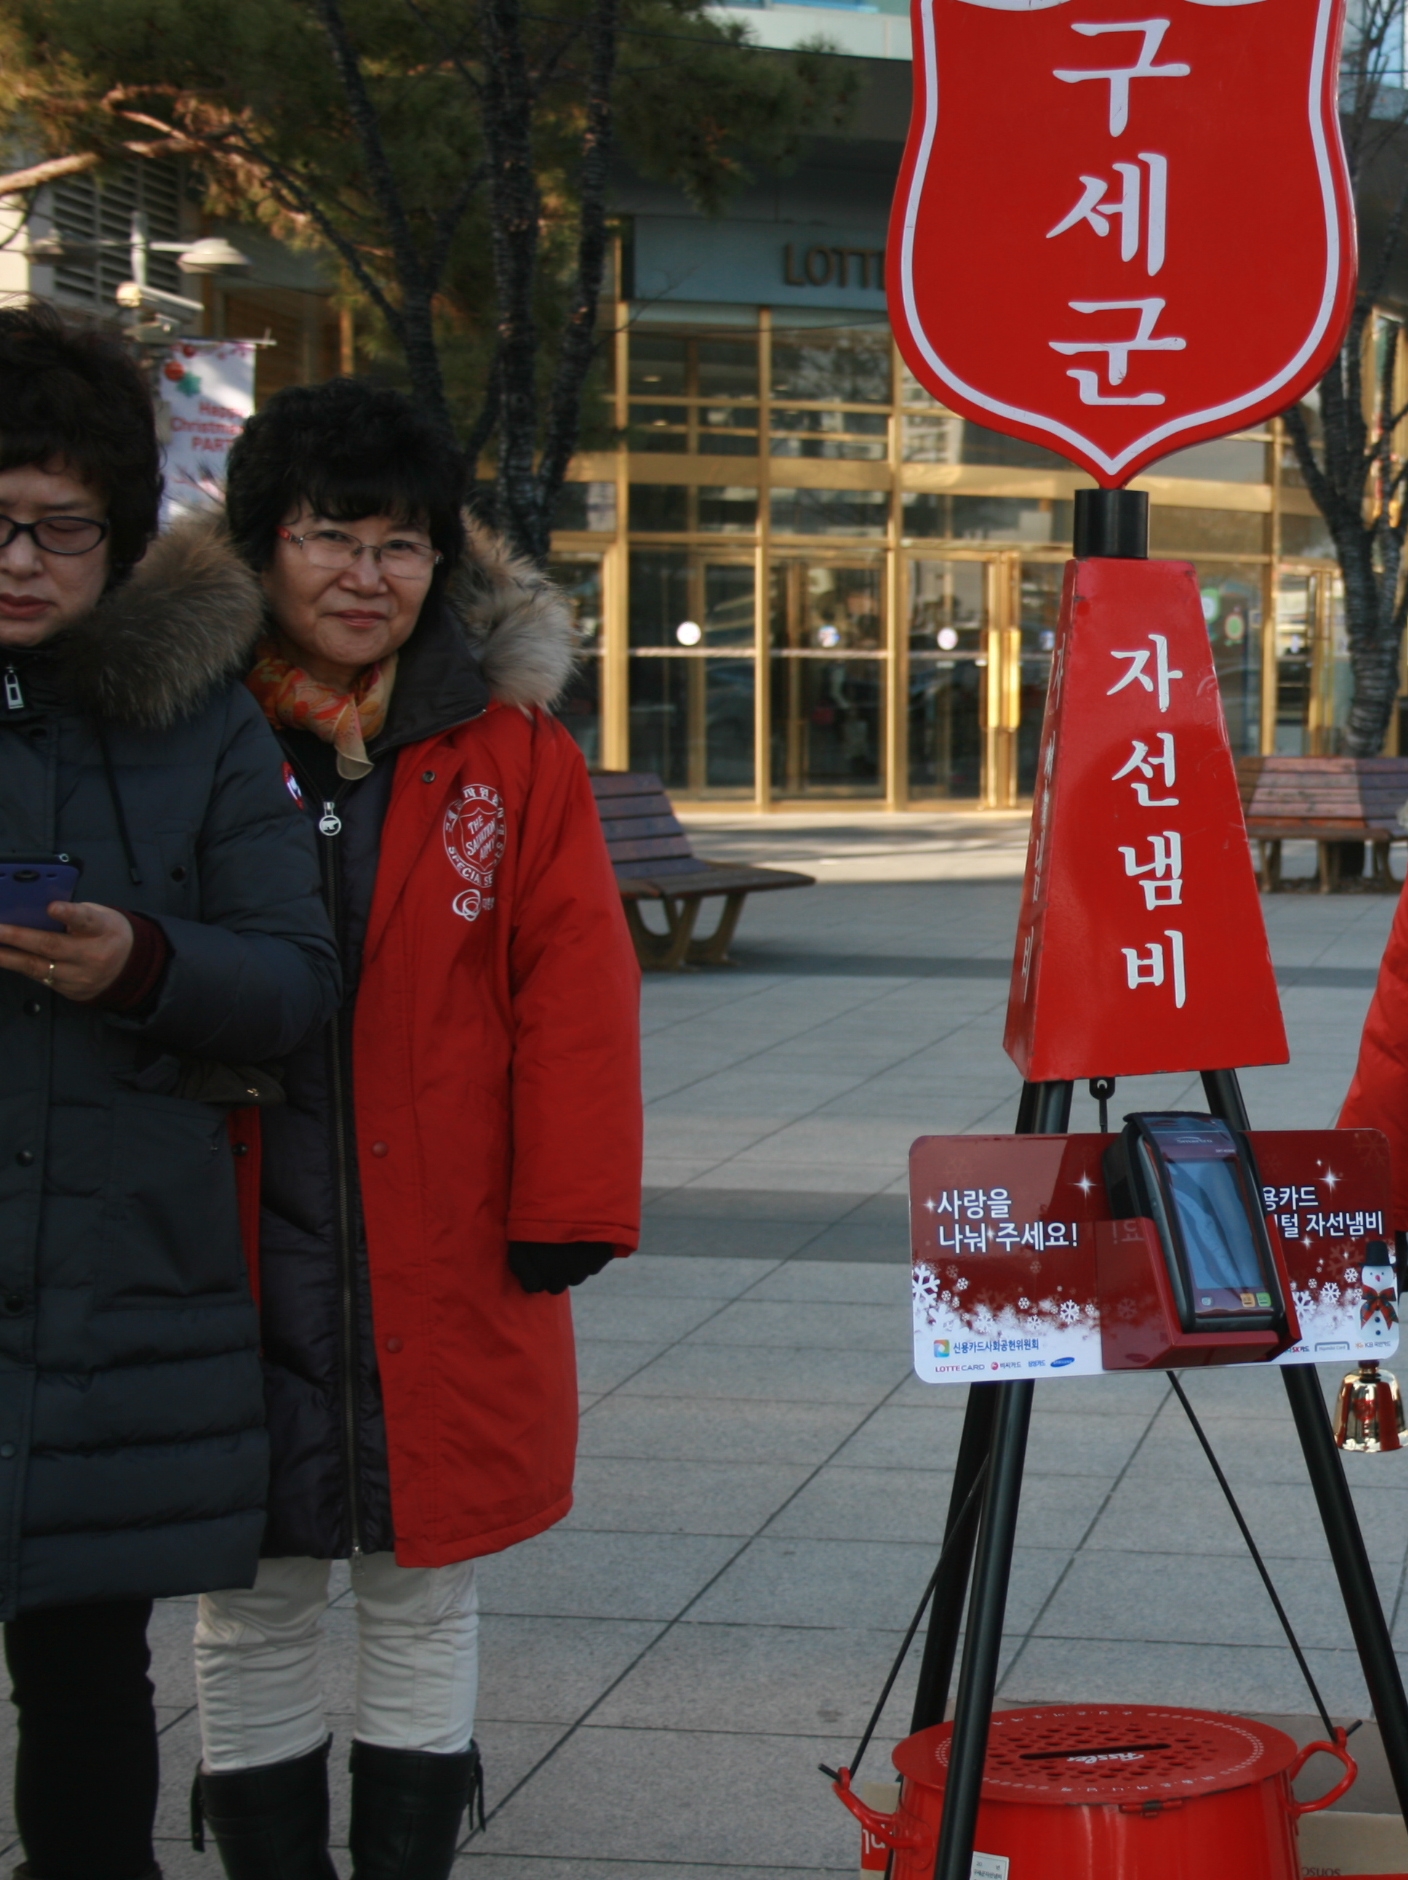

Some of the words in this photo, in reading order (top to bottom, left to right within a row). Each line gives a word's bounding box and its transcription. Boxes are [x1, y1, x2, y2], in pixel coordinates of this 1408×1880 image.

[1046, 19, 1190, 405] 구세군
[784, 243, 886, 290] LOTT
[192, 436, 234, 451] PART
[467, 815, 484, 835] THE
[1107, 634, 1186, 1009] 자선냄비
[937, 1188, 1012, 1220] 사랑을
[1262, 1186, 1319, 1211] 용카드
[938, 1223, 987, 1254] 나눠
[995, 1221, 1078, 1252] 주세요!
[1274, 1213, 1299, 1238] 털
[1305, 1210, 1383, 1237] 자선냄비
[953, 1338, 1039, 1354] 신용카드사회공헌위원회
[935, 1365, 960, 1373] LOTTE
